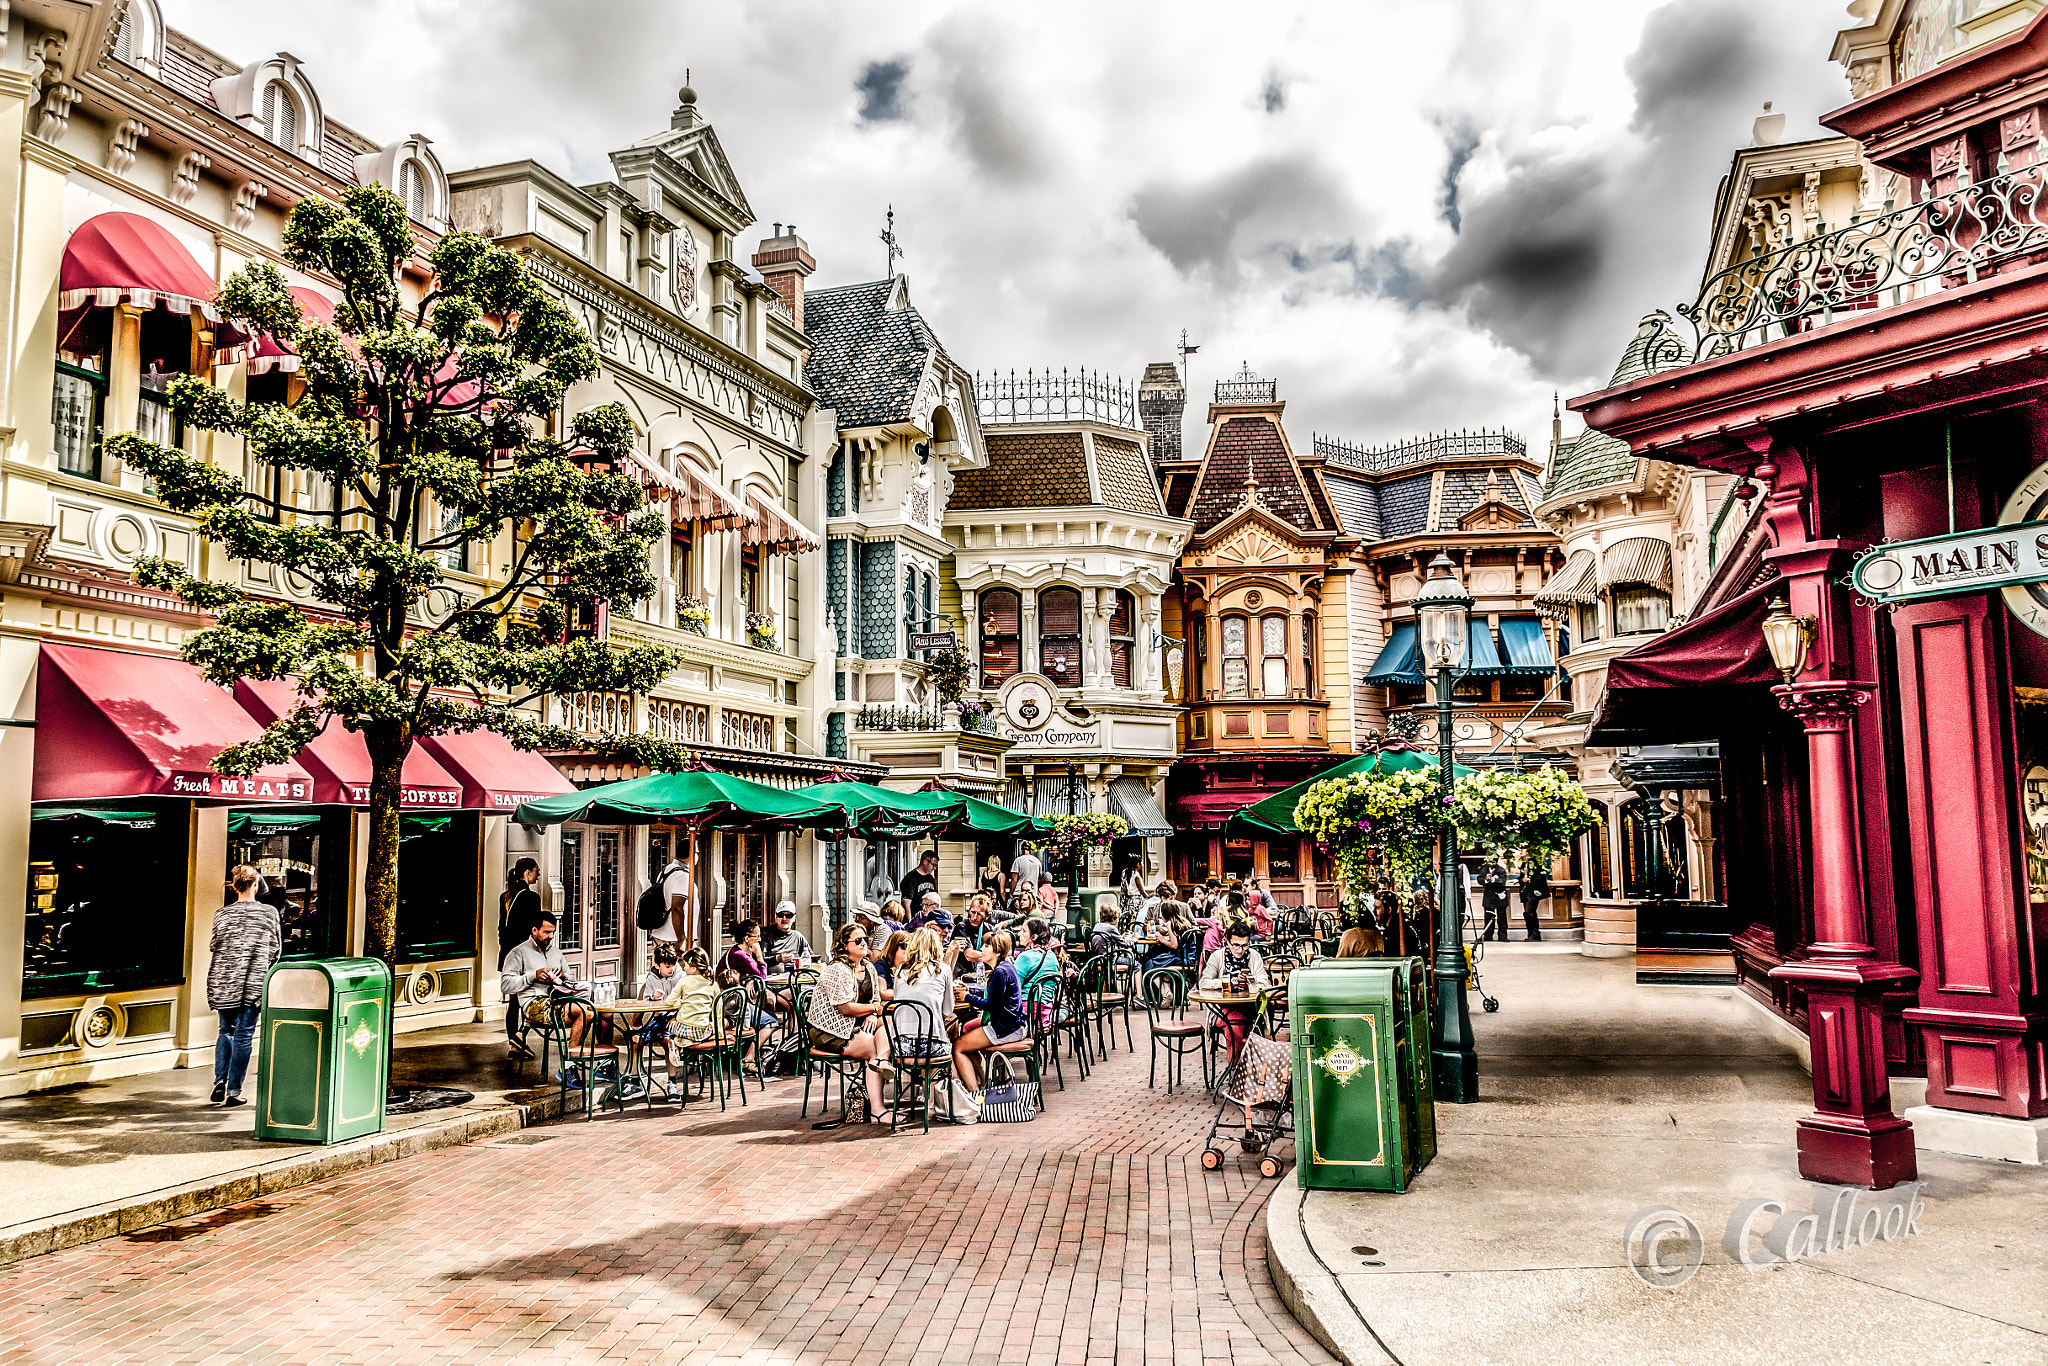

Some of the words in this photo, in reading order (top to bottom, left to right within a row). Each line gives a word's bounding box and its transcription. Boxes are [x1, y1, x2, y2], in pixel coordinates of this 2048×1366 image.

[1911, 541, 2019, 586] MAIN
[1045, 728, 1096, 745] Company
[173, 775, 211, 793] Fresh
[220, 779, 305, 797] MEATS
